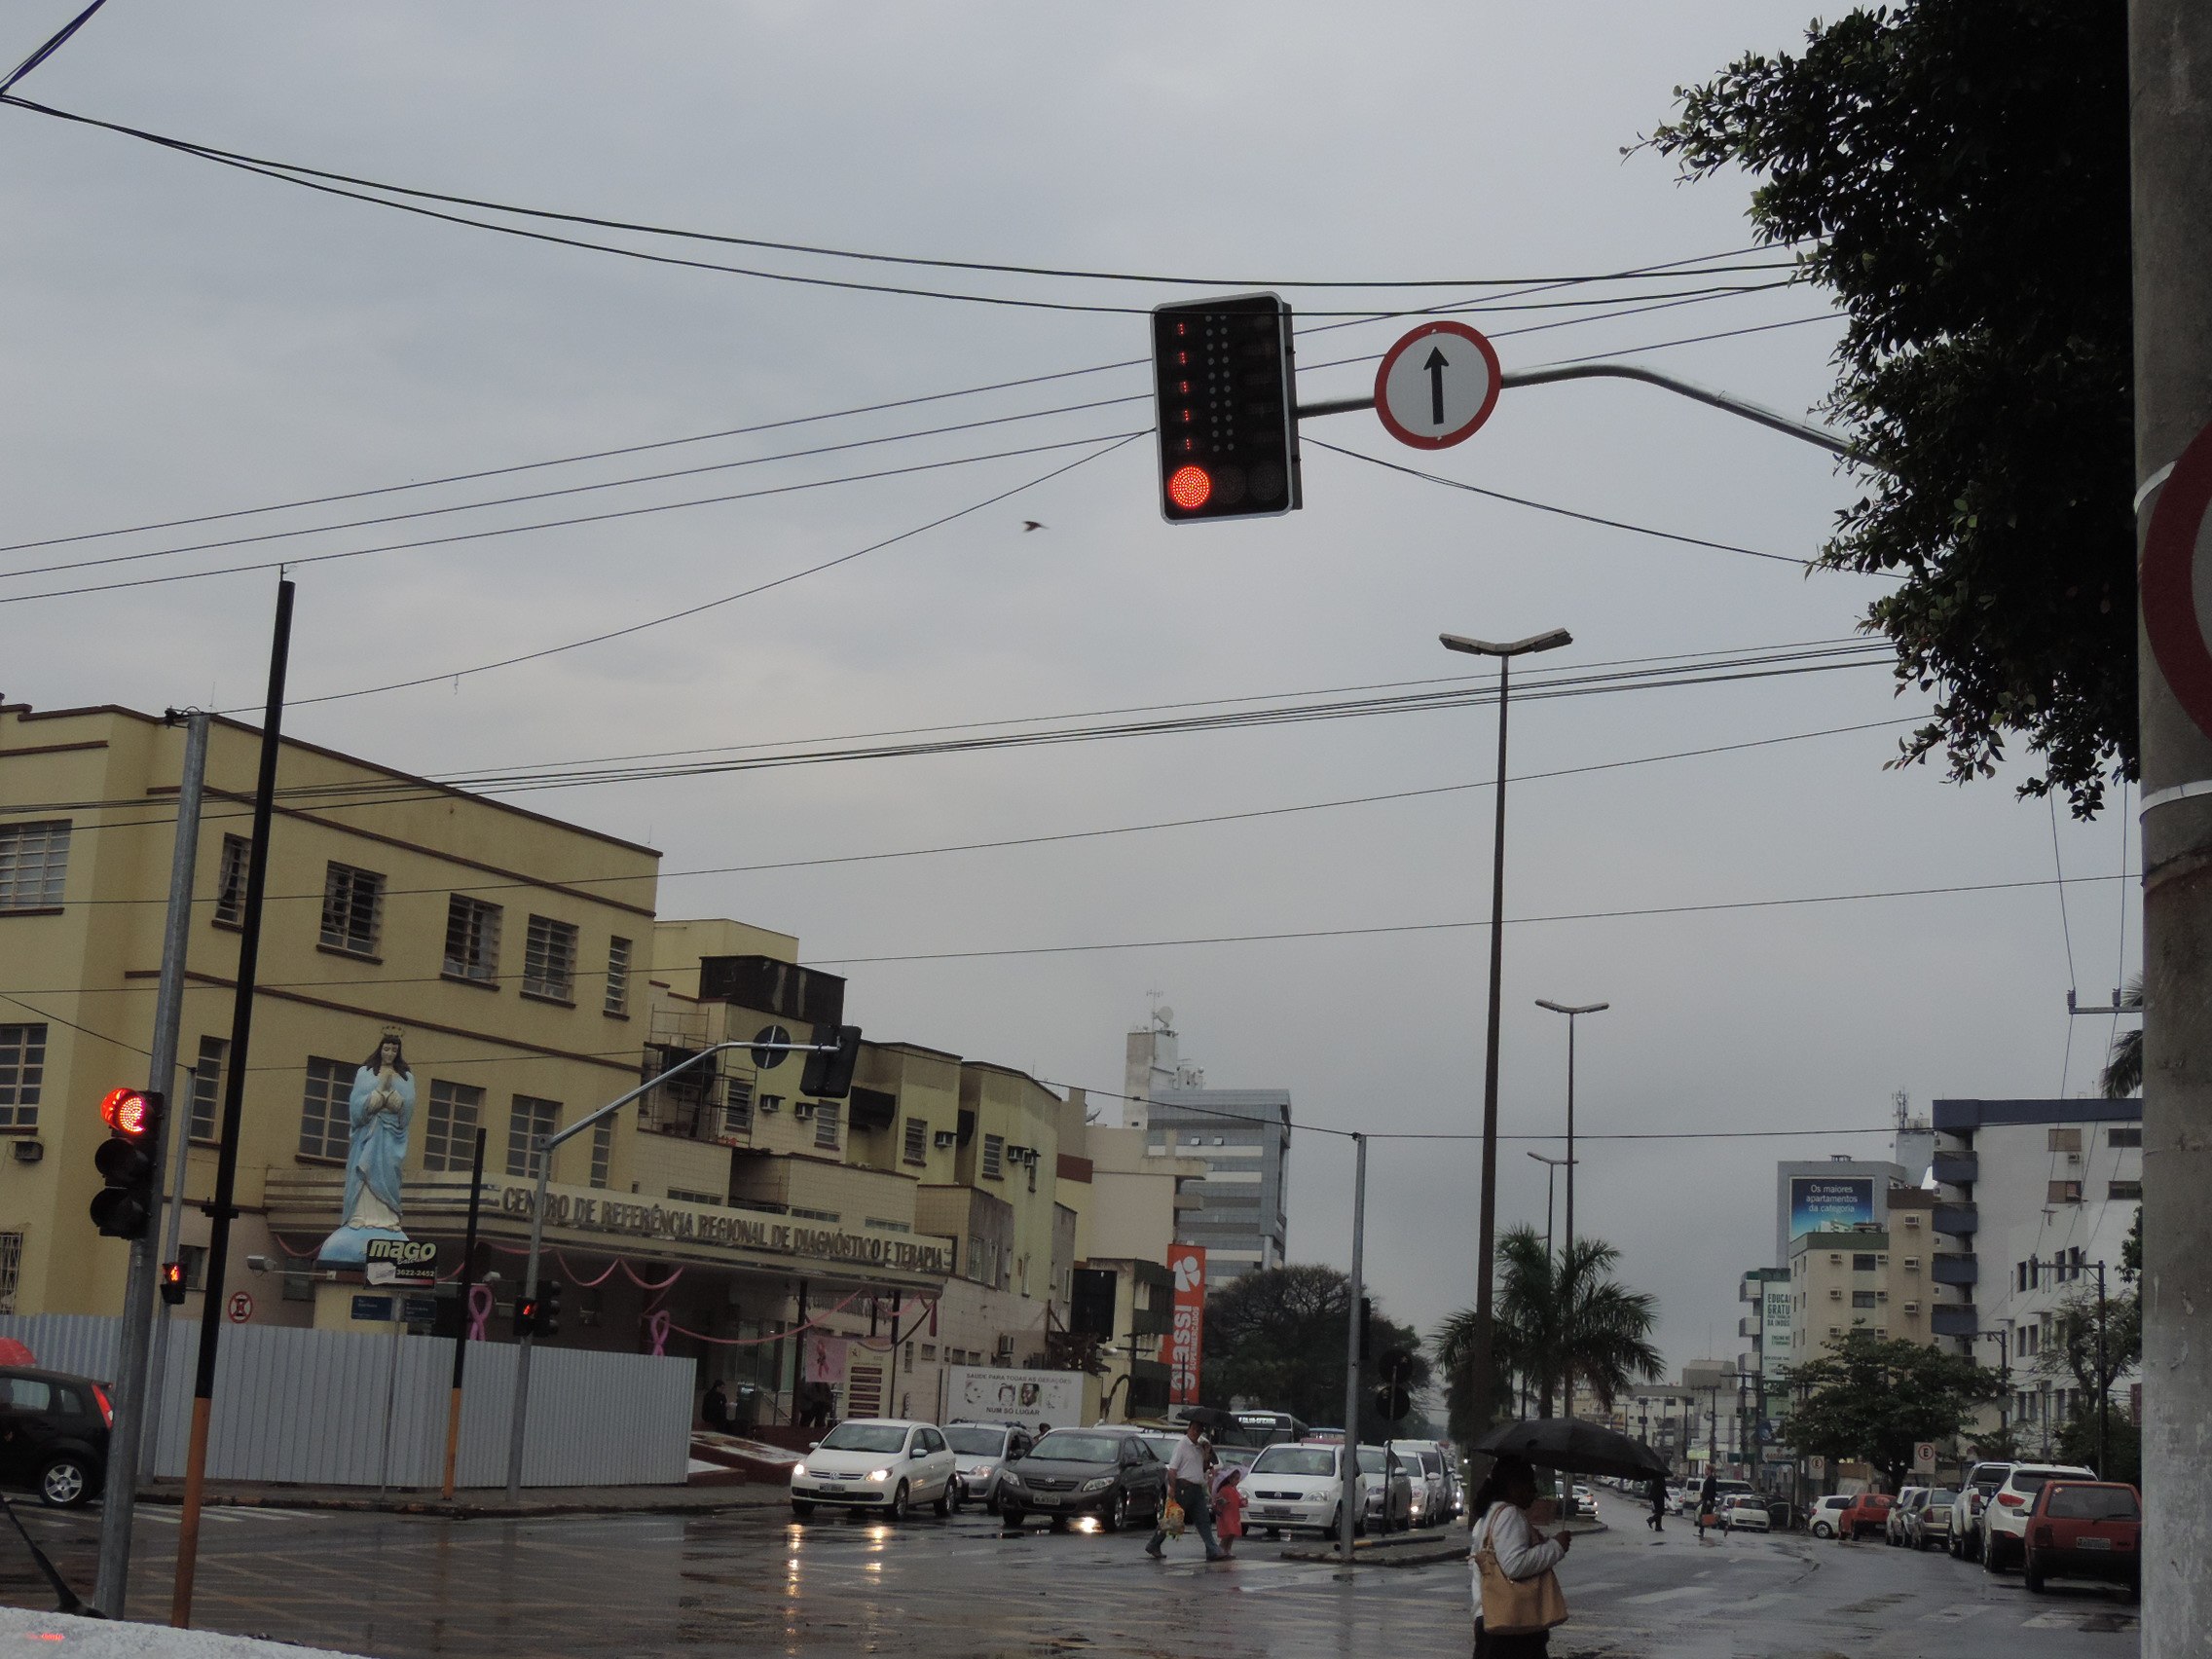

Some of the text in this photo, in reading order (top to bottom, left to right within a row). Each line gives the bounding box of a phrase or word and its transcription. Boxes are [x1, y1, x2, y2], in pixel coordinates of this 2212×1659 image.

[1824, 1185, 1853, 1194] maiores
[1806, 1196, 1858, 1204] apartamentos
[1821, 1204, 1855, 1214] categoria
[502, 1186, 943, 1269] CENRO DE REFERÊNCIA REGIONAL DE DIAGNÓSTICO E TERAPIA
[397, 1269, 435, 1277] 3622-2452
[1190, 1307, 1198, 1371] SUPERMERCADOS
